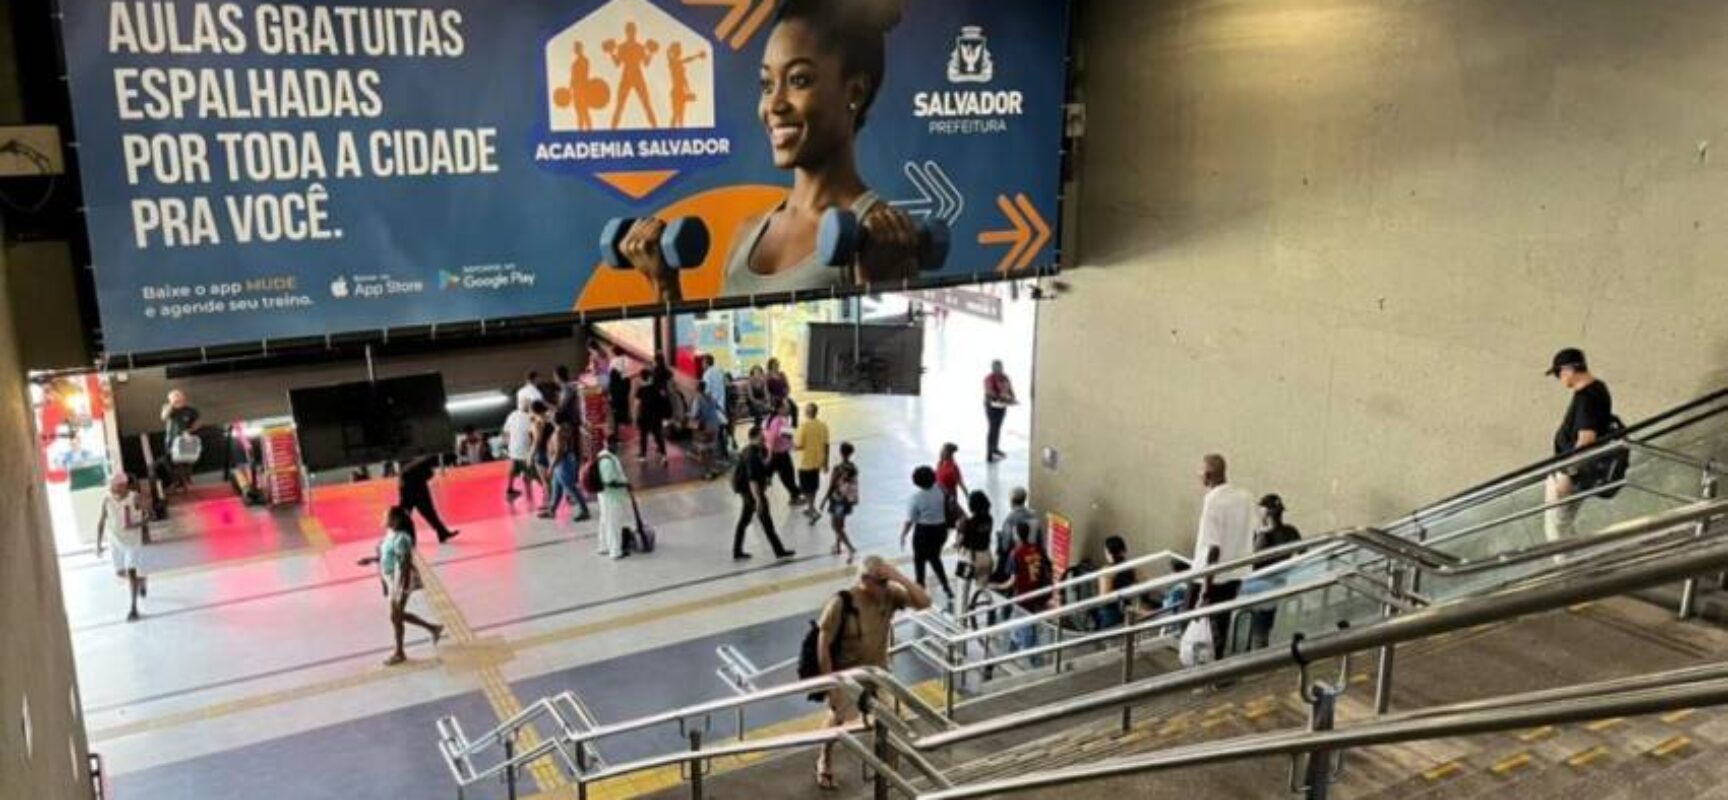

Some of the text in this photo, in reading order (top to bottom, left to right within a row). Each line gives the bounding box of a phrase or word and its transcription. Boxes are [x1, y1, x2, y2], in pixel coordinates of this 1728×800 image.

[108, 1, 464, 56] AULAS GRATUITAS
[113, 68, 383, 119] ESPALHADAS
[913, 90, 1024, 117] SALVADOR
[928, 118, 1008, 135] PREFEITURA
[123, 128, 500, 184] POR TODA A CIDADE
[535, 137, 731, 161] ACADEMIA SALVADOR
[132, 183, 343, 248] PRA VOCÊ.
[142, 284, 191, 300] Baixe
[195, 285, 206, 296] o
[209, 282, 243, 296] app
[354, 279, 424, 297] App Store
[463, 270, 536, 289] Google Play
[160, 300, 225, 318] agende
[229, 298, 259, 312] seu
